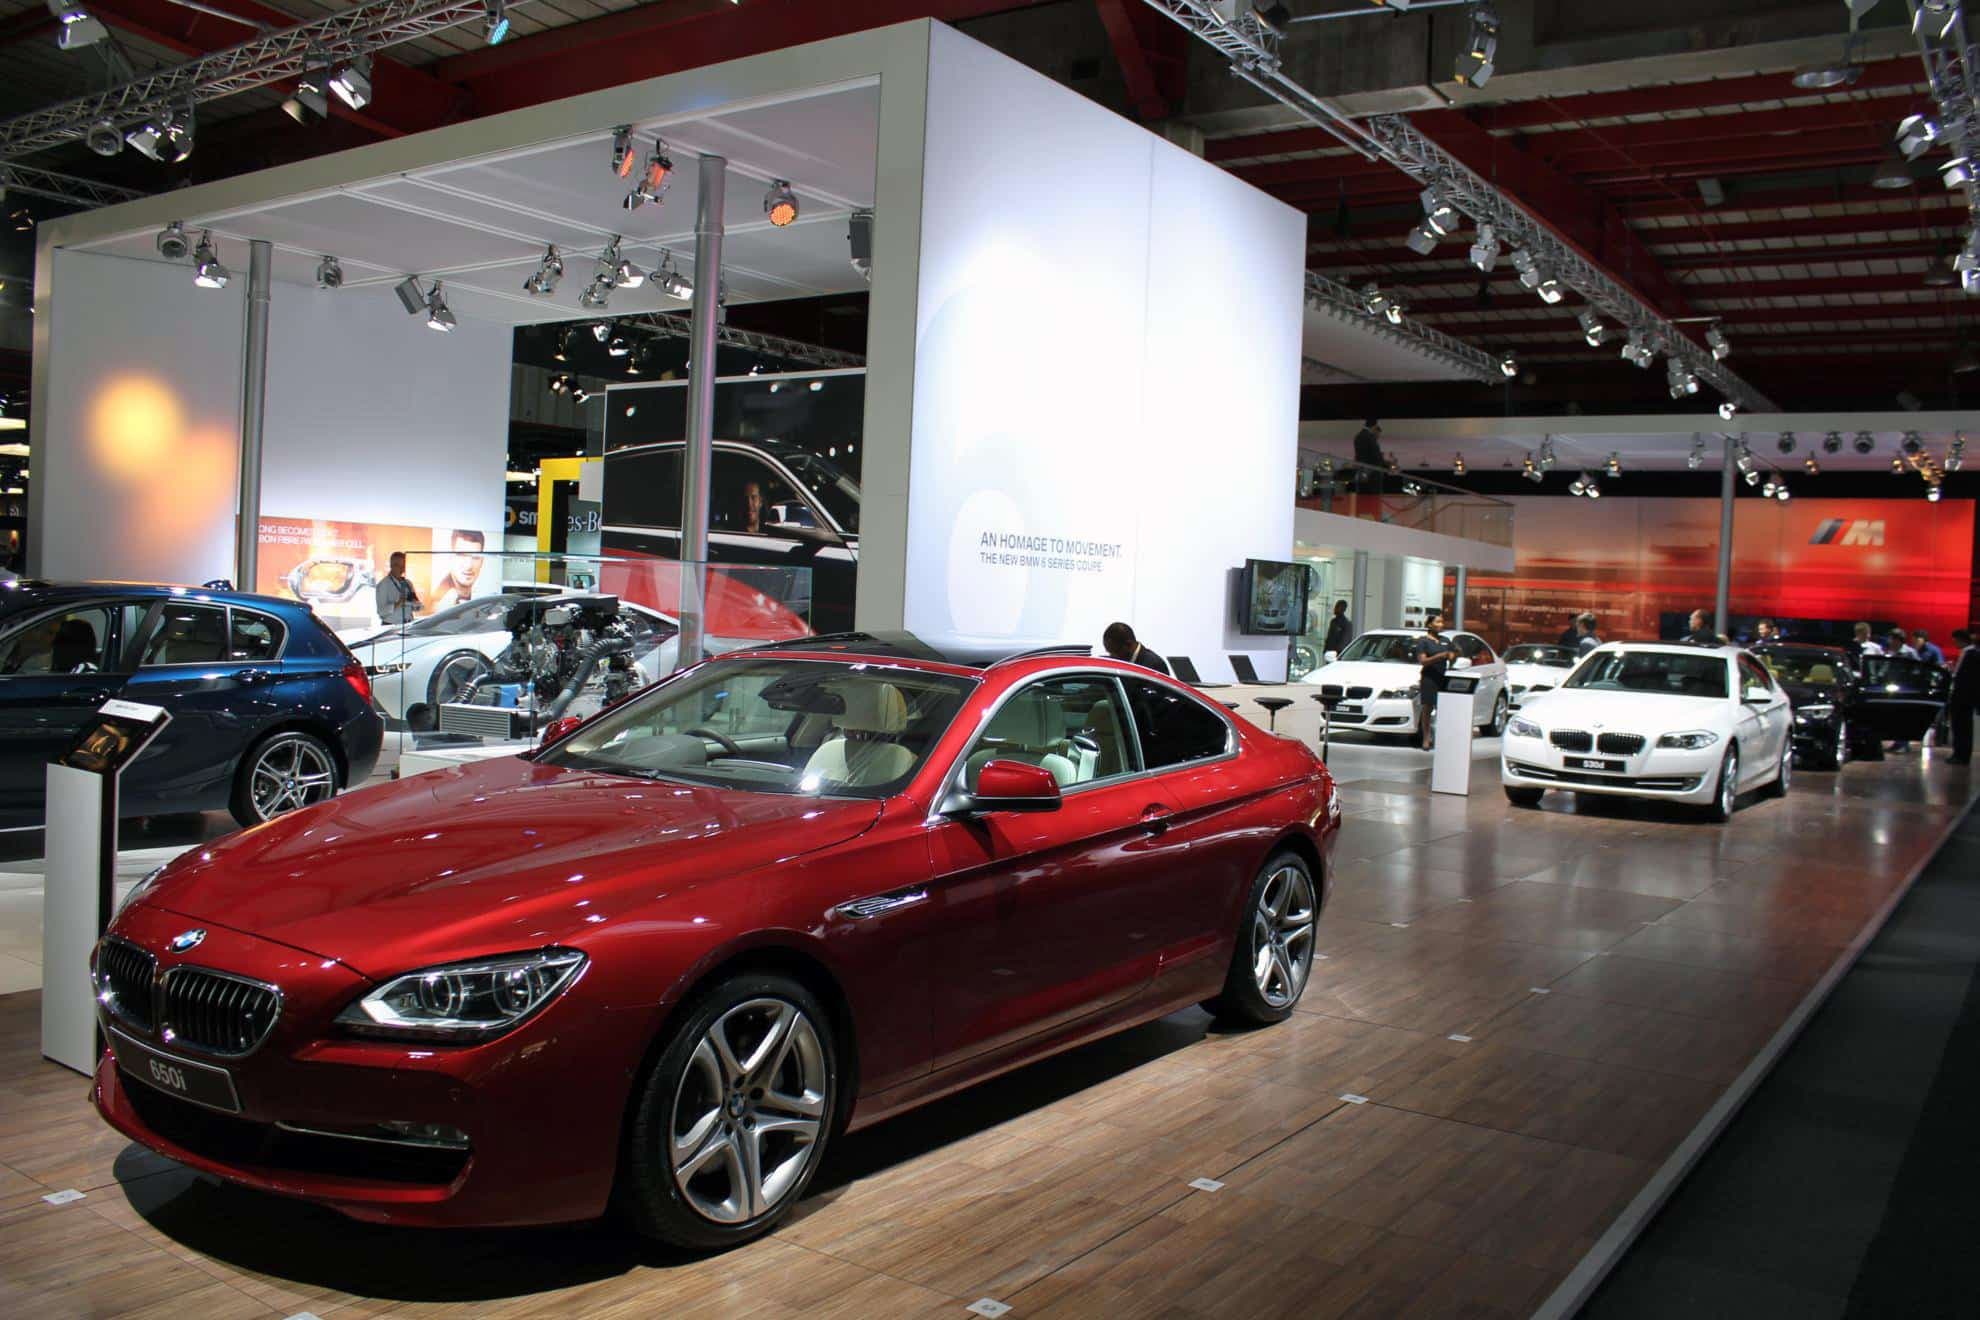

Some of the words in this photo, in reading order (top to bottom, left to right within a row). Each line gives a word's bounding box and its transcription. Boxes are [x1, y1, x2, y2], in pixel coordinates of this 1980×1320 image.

[981, 532, 997, 547] AN
[1000, 533, 1047, 552] HOMAGE
[1050, 538, 1064, 553] TO
[1065, 540, 1123, 559] MOVEMENT.
[980, 552, 997, 564] THE
[999, 553, 1018, 566] NEW
[1020, 555, 1040, 568] BMW
[1047, 557, 1075, 570] SERIES
[149, 1059, 187, 1091] 650i
